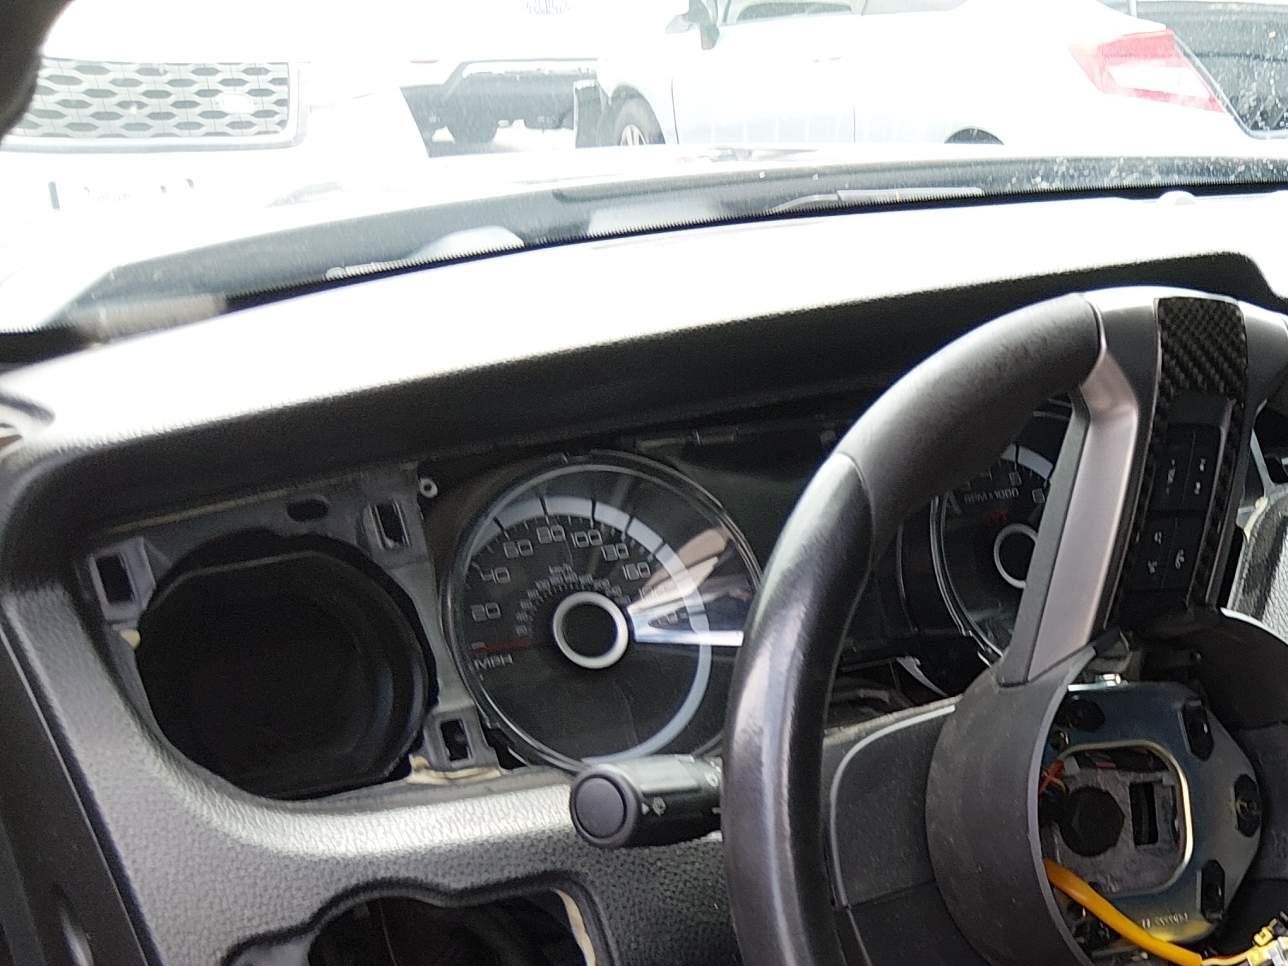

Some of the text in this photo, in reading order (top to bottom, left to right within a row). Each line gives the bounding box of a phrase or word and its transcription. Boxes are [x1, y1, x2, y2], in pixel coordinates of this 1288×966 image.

[570, 529, 603, 548] 100
[479, 566, 511, 584] 40
[474, 654, 513, 671] MPH
